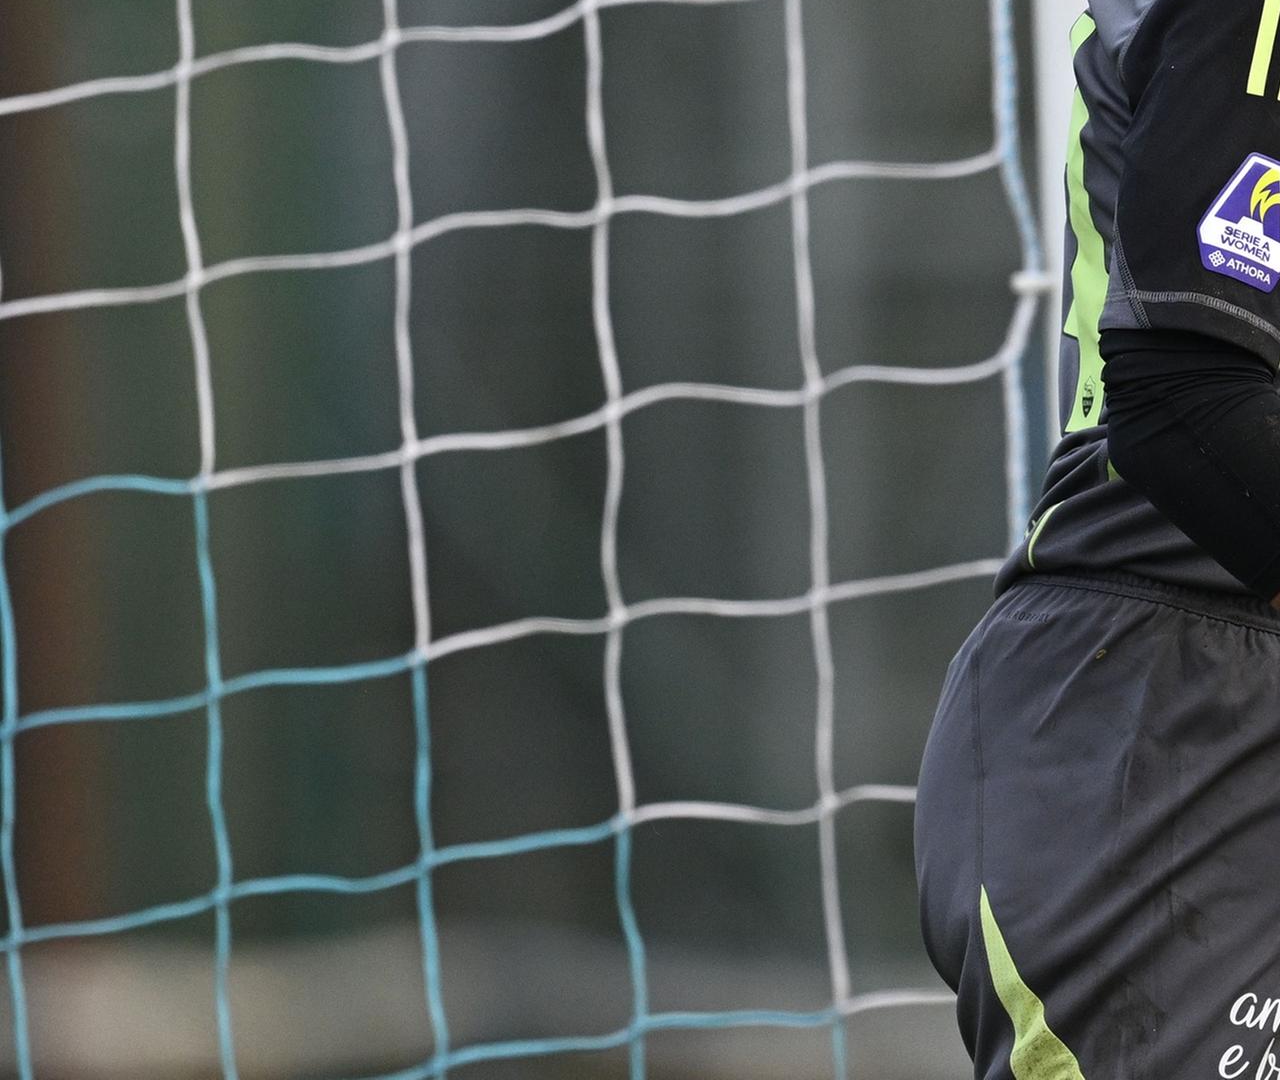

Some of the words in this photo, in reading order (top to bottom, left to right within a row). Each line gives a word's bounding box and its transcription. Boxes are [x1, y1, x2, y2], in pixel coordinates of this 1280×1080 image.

[1220, 234, 1271, 262] WOMEN
[1224, 225, 1260, 247] SERIE
[1261, 241, 1271, 252] A
[1226, 258, 1271, 285] ATHORA
[1218, 1044, 1250, 1079] e
